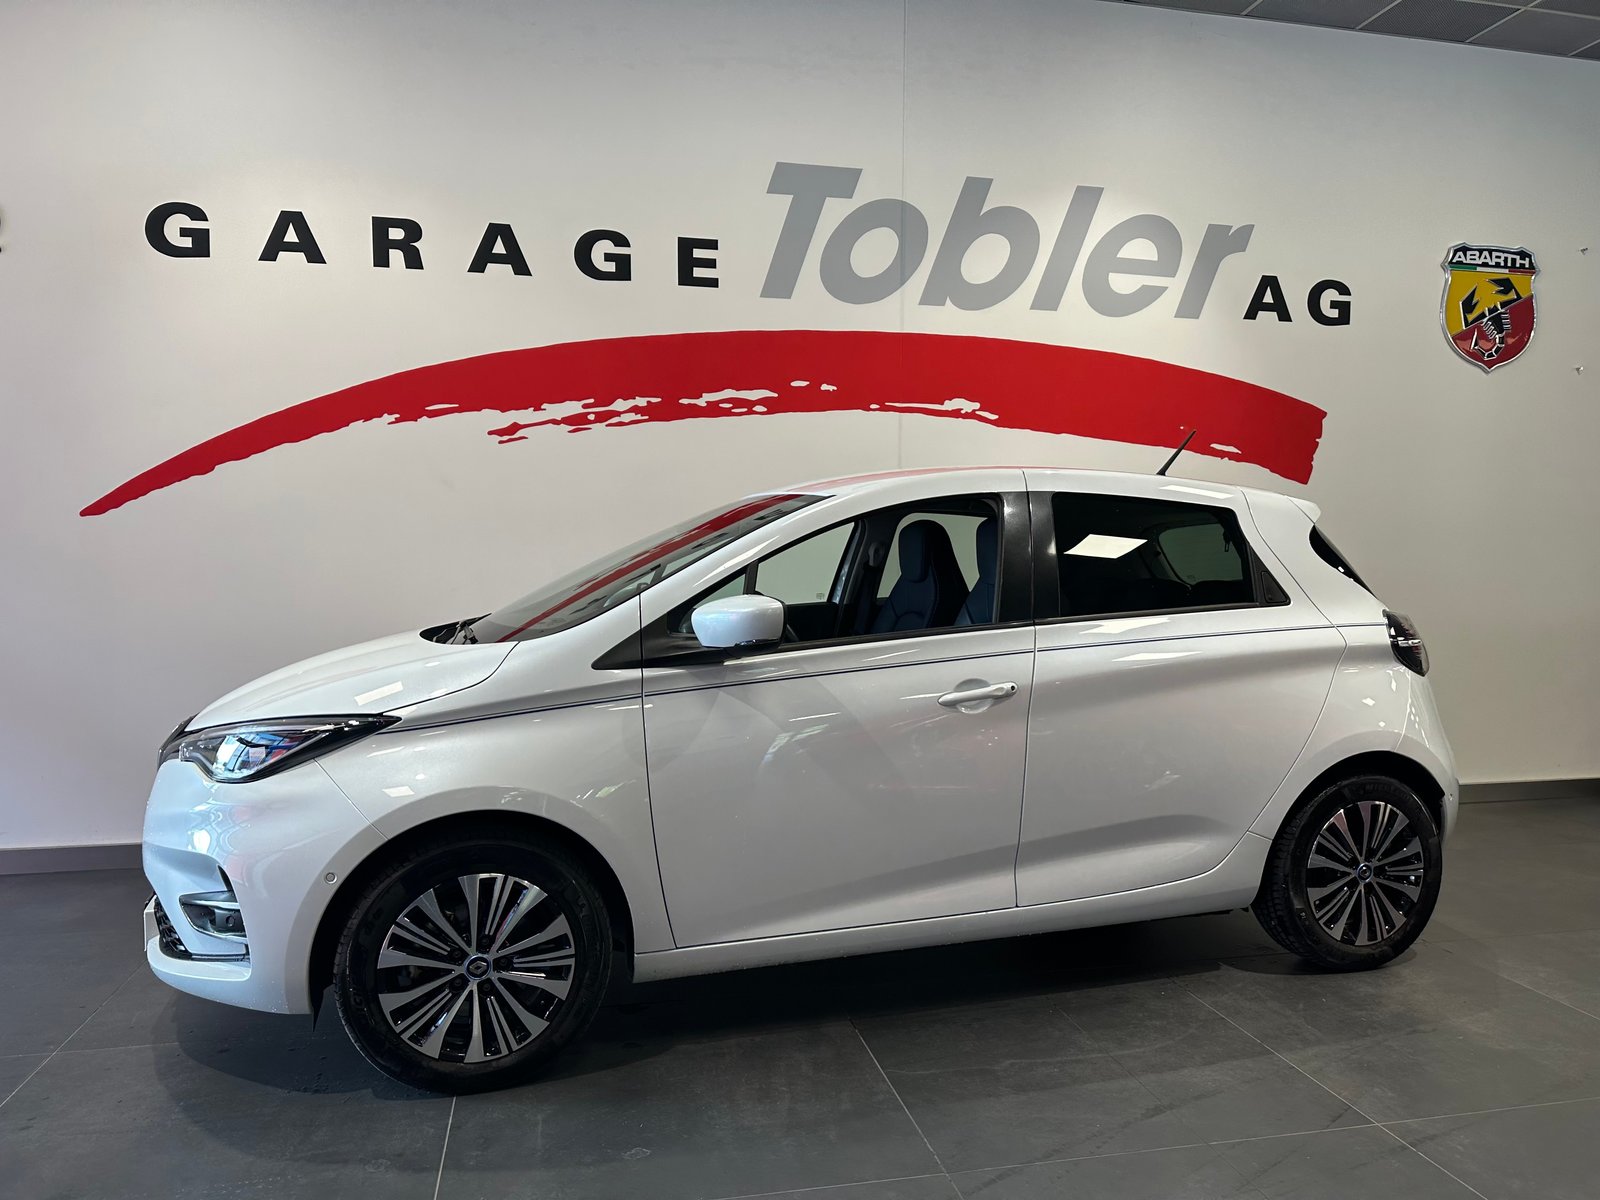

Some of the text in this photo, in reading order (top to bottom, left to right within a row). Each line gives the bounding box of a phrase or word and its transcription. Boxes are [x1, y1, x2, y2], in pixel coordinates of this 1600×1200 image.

[144, 161, 1353, 327] GARAGE Tobler AG
[1452, 250, 1530, 268] ABARTH
